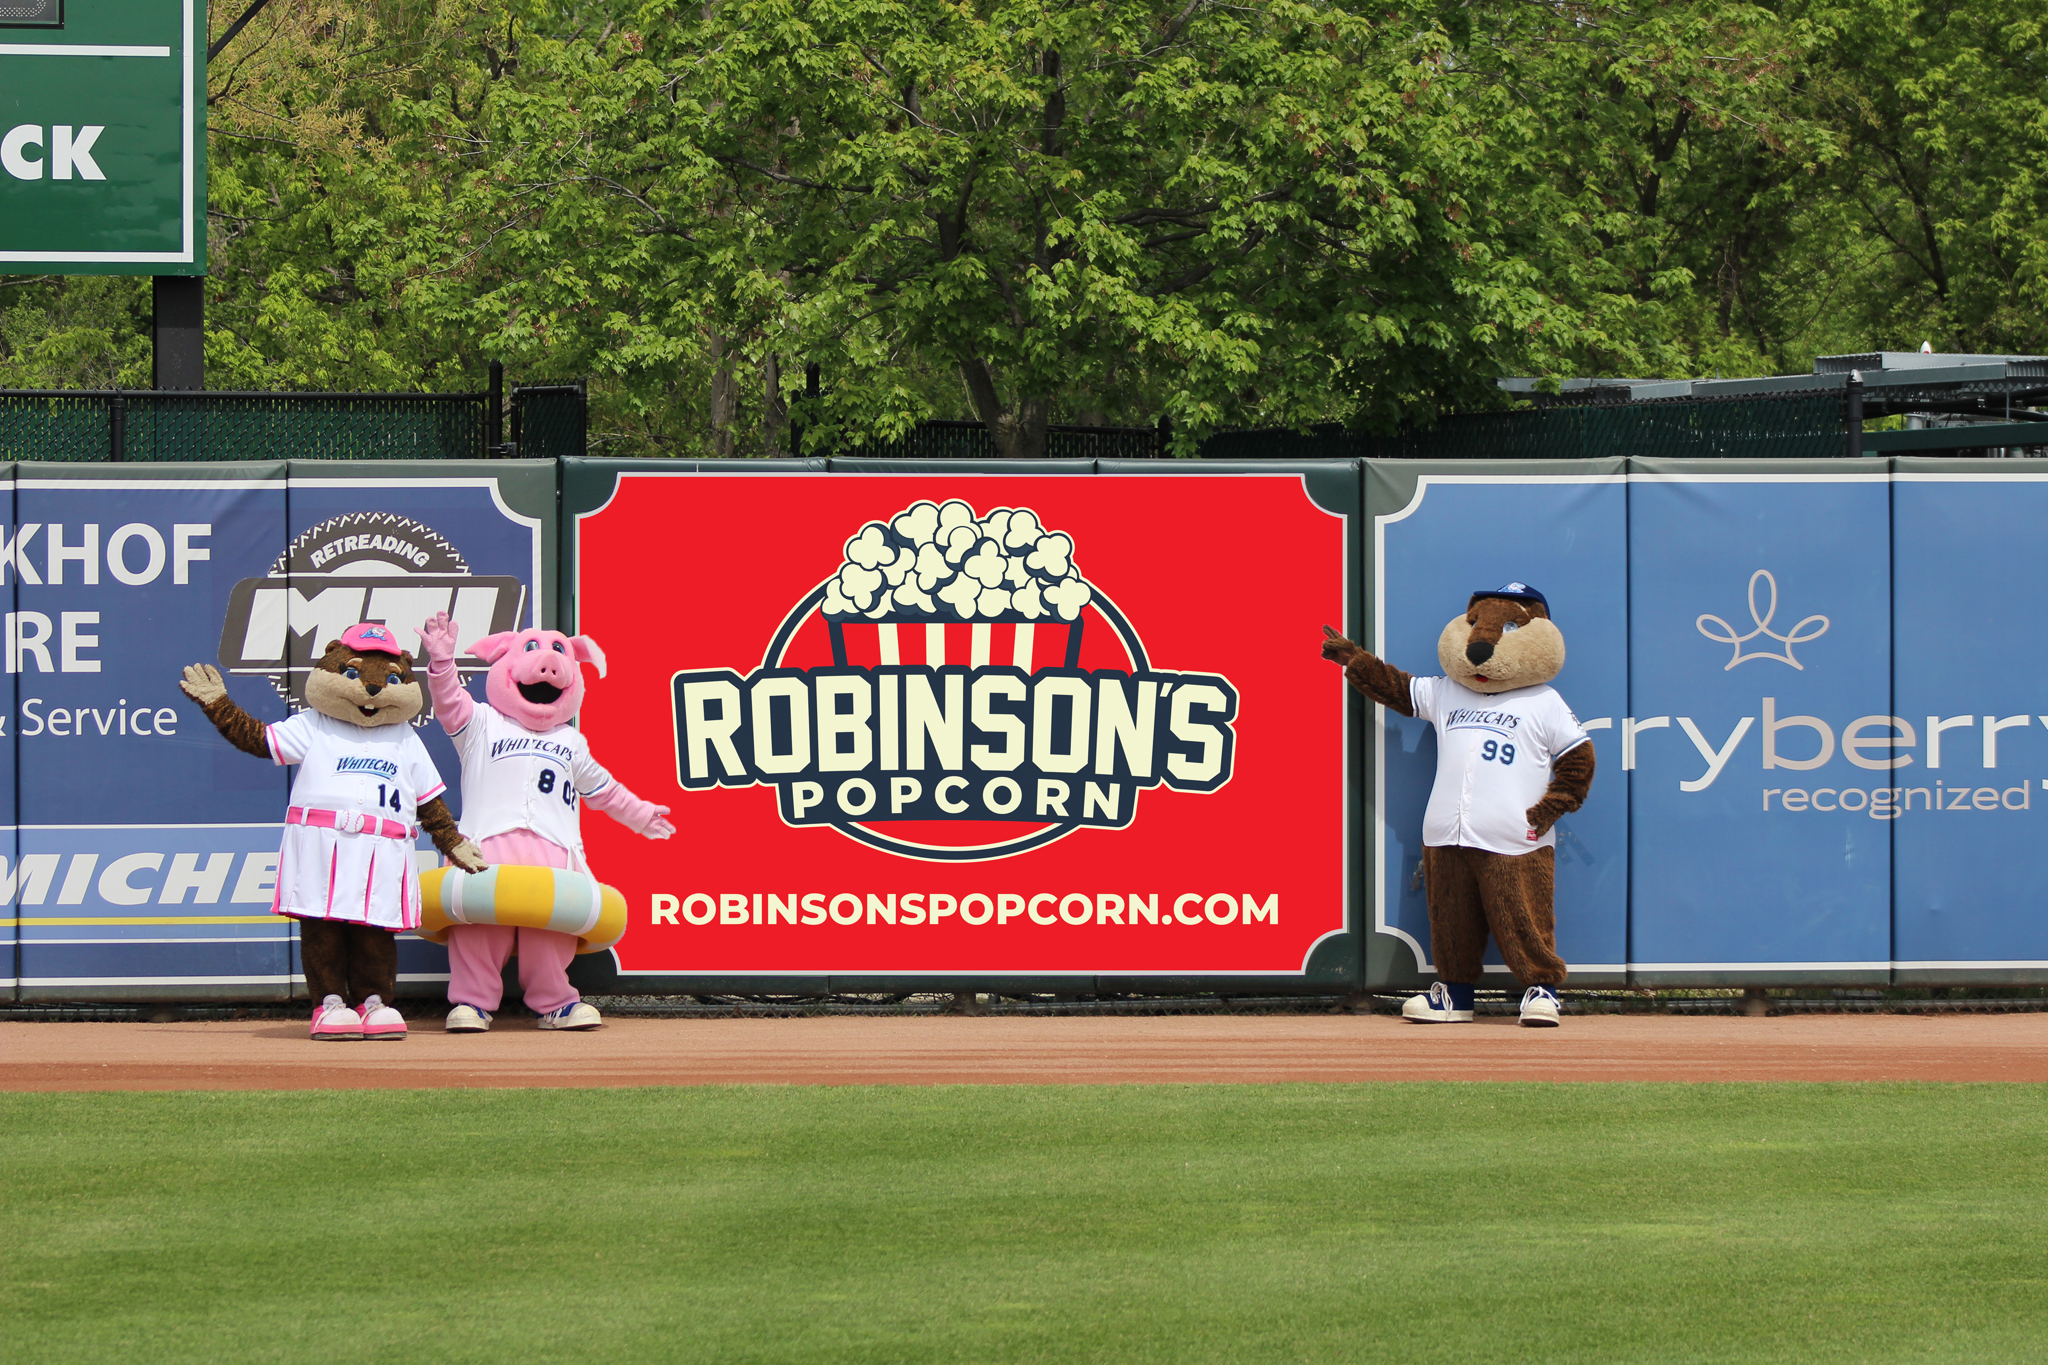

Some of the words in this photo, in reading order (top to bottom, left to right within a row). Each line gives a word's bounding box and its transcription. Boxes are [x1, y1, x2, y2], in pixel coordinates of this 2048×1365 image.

[0, 124, 107, 181] CK
[0, 522, 212, 585] KHOF
[310, 533, 430, 569] RETREADING
[5, 611, 102, 674] RE
[21, 697, 178, 737] Service
[683, 674, 1227, 782] ROBINSON'S
[1446, 708, 1520, 729] WHITECAPS
[337, 755, 399, 776] WHITECAPS
[1481, 739, 1515, 765] 99
[377, 783, 402, 813] 14
[791, 775, 1121, 821] POPCORN
[1762, 779, 2030, 820] recognized
[651, 892, 1280, 926] ROBINSONSPOPCORN.COM
